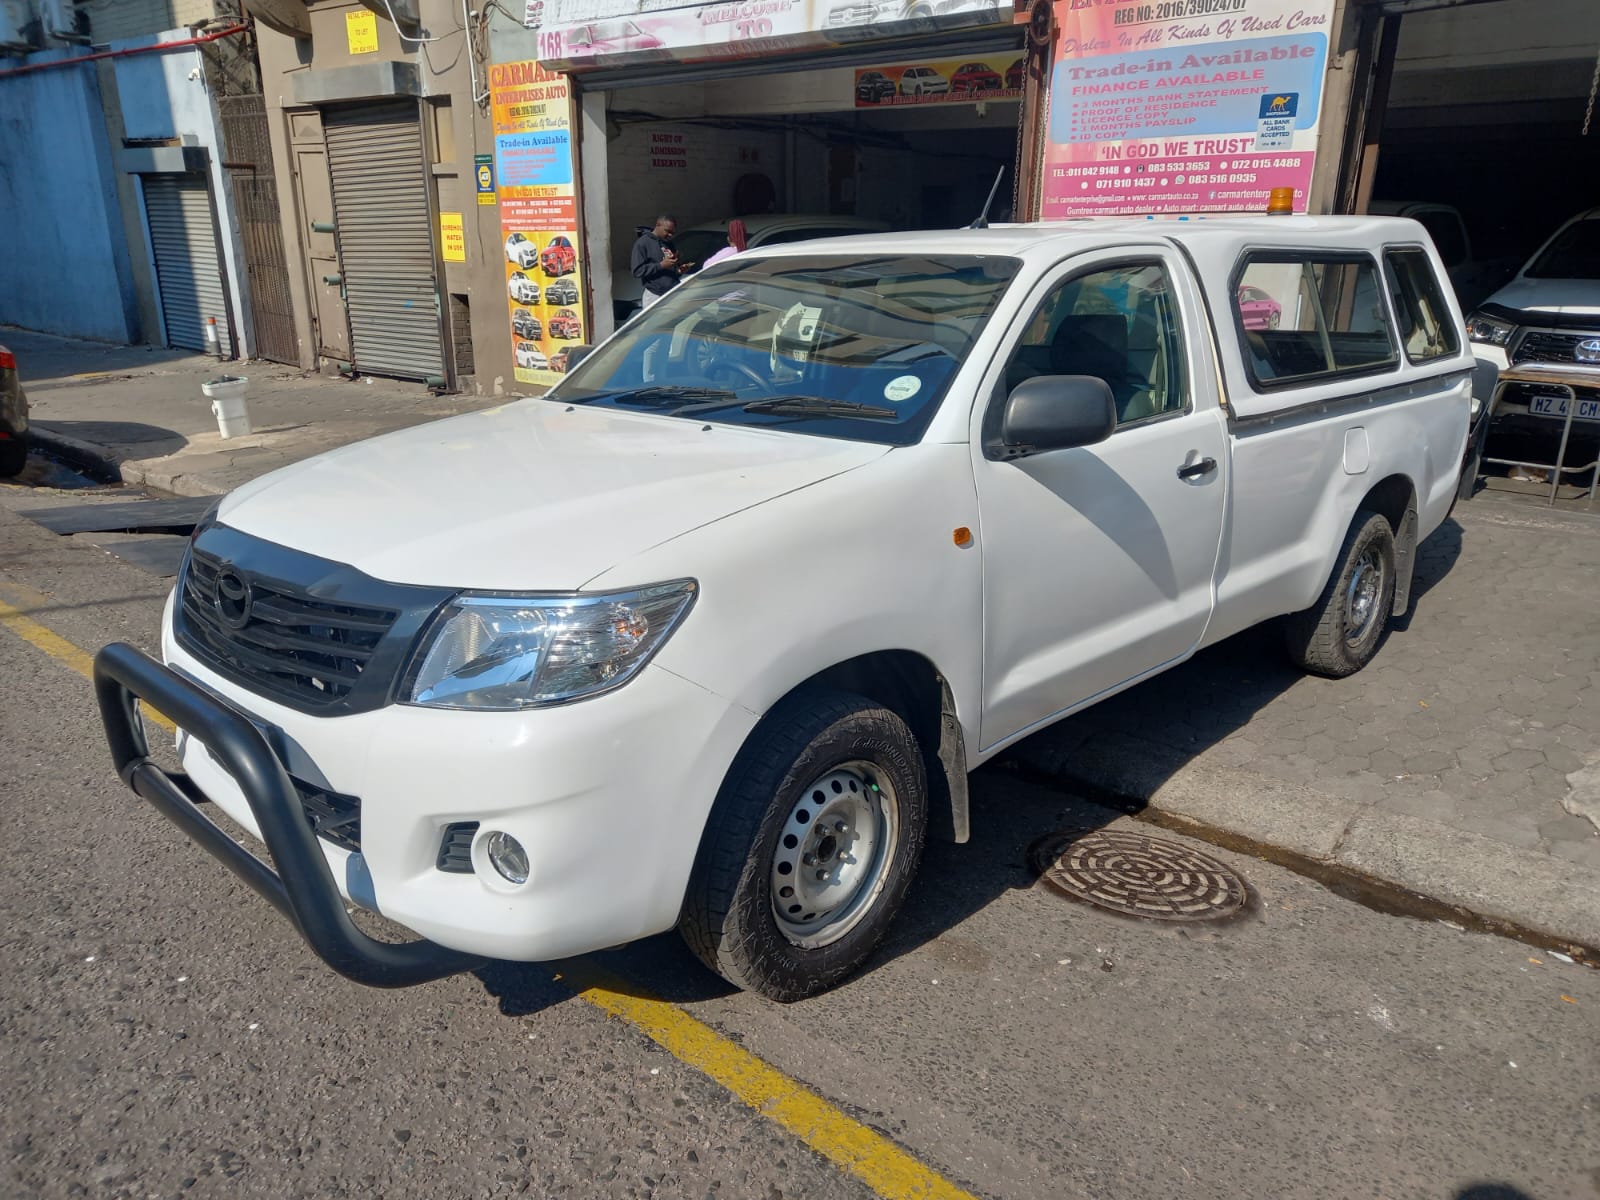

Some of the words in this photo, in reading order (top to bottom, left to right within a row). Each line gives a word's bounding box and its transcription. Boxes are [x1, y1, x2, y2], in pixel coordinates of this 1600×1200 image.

[1114, 7, 1134, 24] REG
[1137, 5, 1154, 22] NO:
[736, 18, 772, 38] TO
[1117, 32, 1133, 47] In
[1136, 28, 1163, 46] All
[1168, 24, 1211, 40] Kinds
[1217, 19, 1237, 39] Of
[1241, 15, 1284, 32] Used
[1286, 10, 1327, 30] Cars
[540, 31, 562, 58] 168
[1069, 59, 1172, 80] Trade-in
[1179, 44, 1316, 69] Available
[1071, 79, 1149, 96] FINANCE
[1155, 69, 1265, 88] AVAILABLE
[495, 87, 544, 105] ENTERPRISES
[545, 85, 567, 99] AUTO
[1091, 97, 1143, 107] MONTHS
[1147, 93, 1183, 103] BANK
[1187, 86, 1269, 99] STATEMENT
[1080, 107, 1121, 117] PROOF
[1124, 105, 1140, 113] OF
[1144, 99, 1217, 112] RESIDENCE
[1080, 114, 1133, 124] LICENCE
[1135, 111, 1169, 120] COPY
[1090, 122, 1141, 132] MONTHS
[1145, 117, 1197, 127] PAYSLIP
[500, 138, 530, 149] Trade-in
[532, 135, 568, 147] Available
[652, 133, 673, 143] RIGHT
[674, 135, 682, 143] OF
[1095, 131, 1127, 139] COPY
[650, 146, 686, 156] ADMISSION
[1127, 143, 1159, 158] GOD
[1164, 141, 1188, 156] WE
[652, 159, 687, 168] RESERVED
[1082, 167, 1098, 176] 042
[1099, 166, 1119, 175] 9148
[1167, 162, 1184, 171] 533
[1231, 160, 1250, 169] 072
[1252, 159, 1271, 168] 015
[1273, 158, 1301, 167] 4488
[1096, 179, 1112, 188] 071
[1113, 178, 1131, 188] 910
[1134, 177, 1155, 187] 1437
[1189, 174, 1208, 184] 083
[1210, 174, 1227, 183] 516
[1230, 173, 1256, 183] 0935
[1120, 205, 1134, 214] auto
[1135, 204, 1154, 213] dealer
[1163, 204, 1179, 212] Auto
[1199, 203, 1227, 212] carmart
[1228, 202, 1244, 211] auto
[1535, 399, 1552, 413] MZ
[1579, 402, 1598, 417] CM
